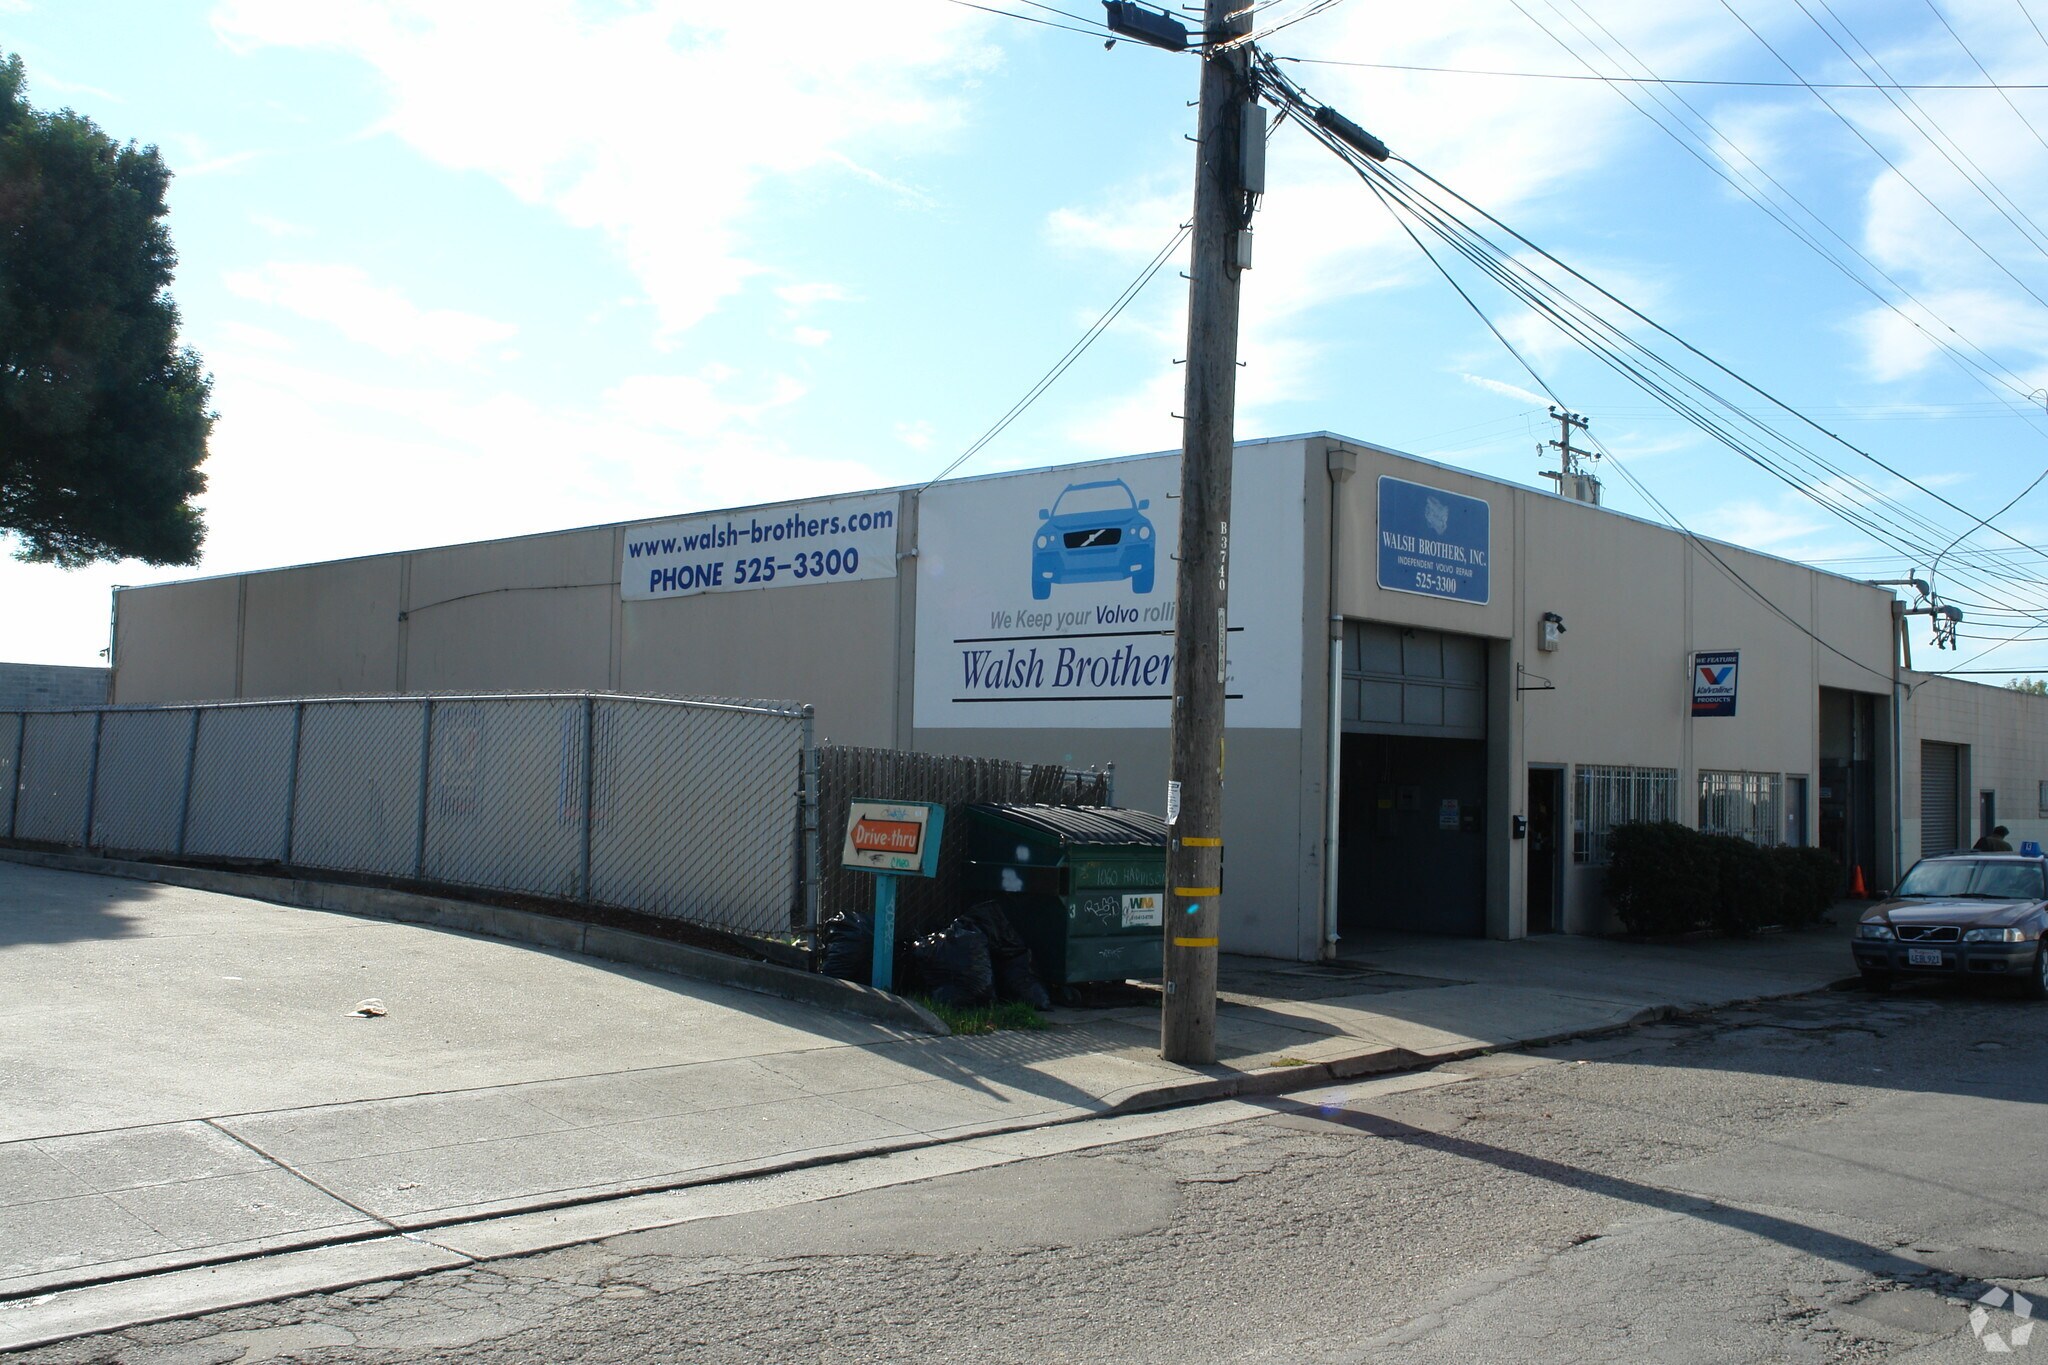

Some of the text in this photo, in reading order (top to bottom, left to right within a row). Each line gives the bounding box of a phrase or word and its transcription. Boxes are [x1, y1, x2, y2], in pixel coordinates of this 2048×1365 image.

[629, 510, 893, 558] www.walsh-brothers.com
[1383, 531, 1487, 566] WALSH BROTHERS, INC.
[650, 547, 859, 592] PHONE 525-3300
[1397, 556, 1473, 577] INDEPENDENT VOLVO REPAIR
[1415, 572, 1457, 593] 525-3300
[991, 602, 1175, 631] We Keep your Volvo rolli
[962, 648, 1045, 689] Walsh
[1052, 644, 1174, 687] Brother
[1697, 686, 1733, 694] Valvoline
[856, 825, 917, 848] Drive-thru
